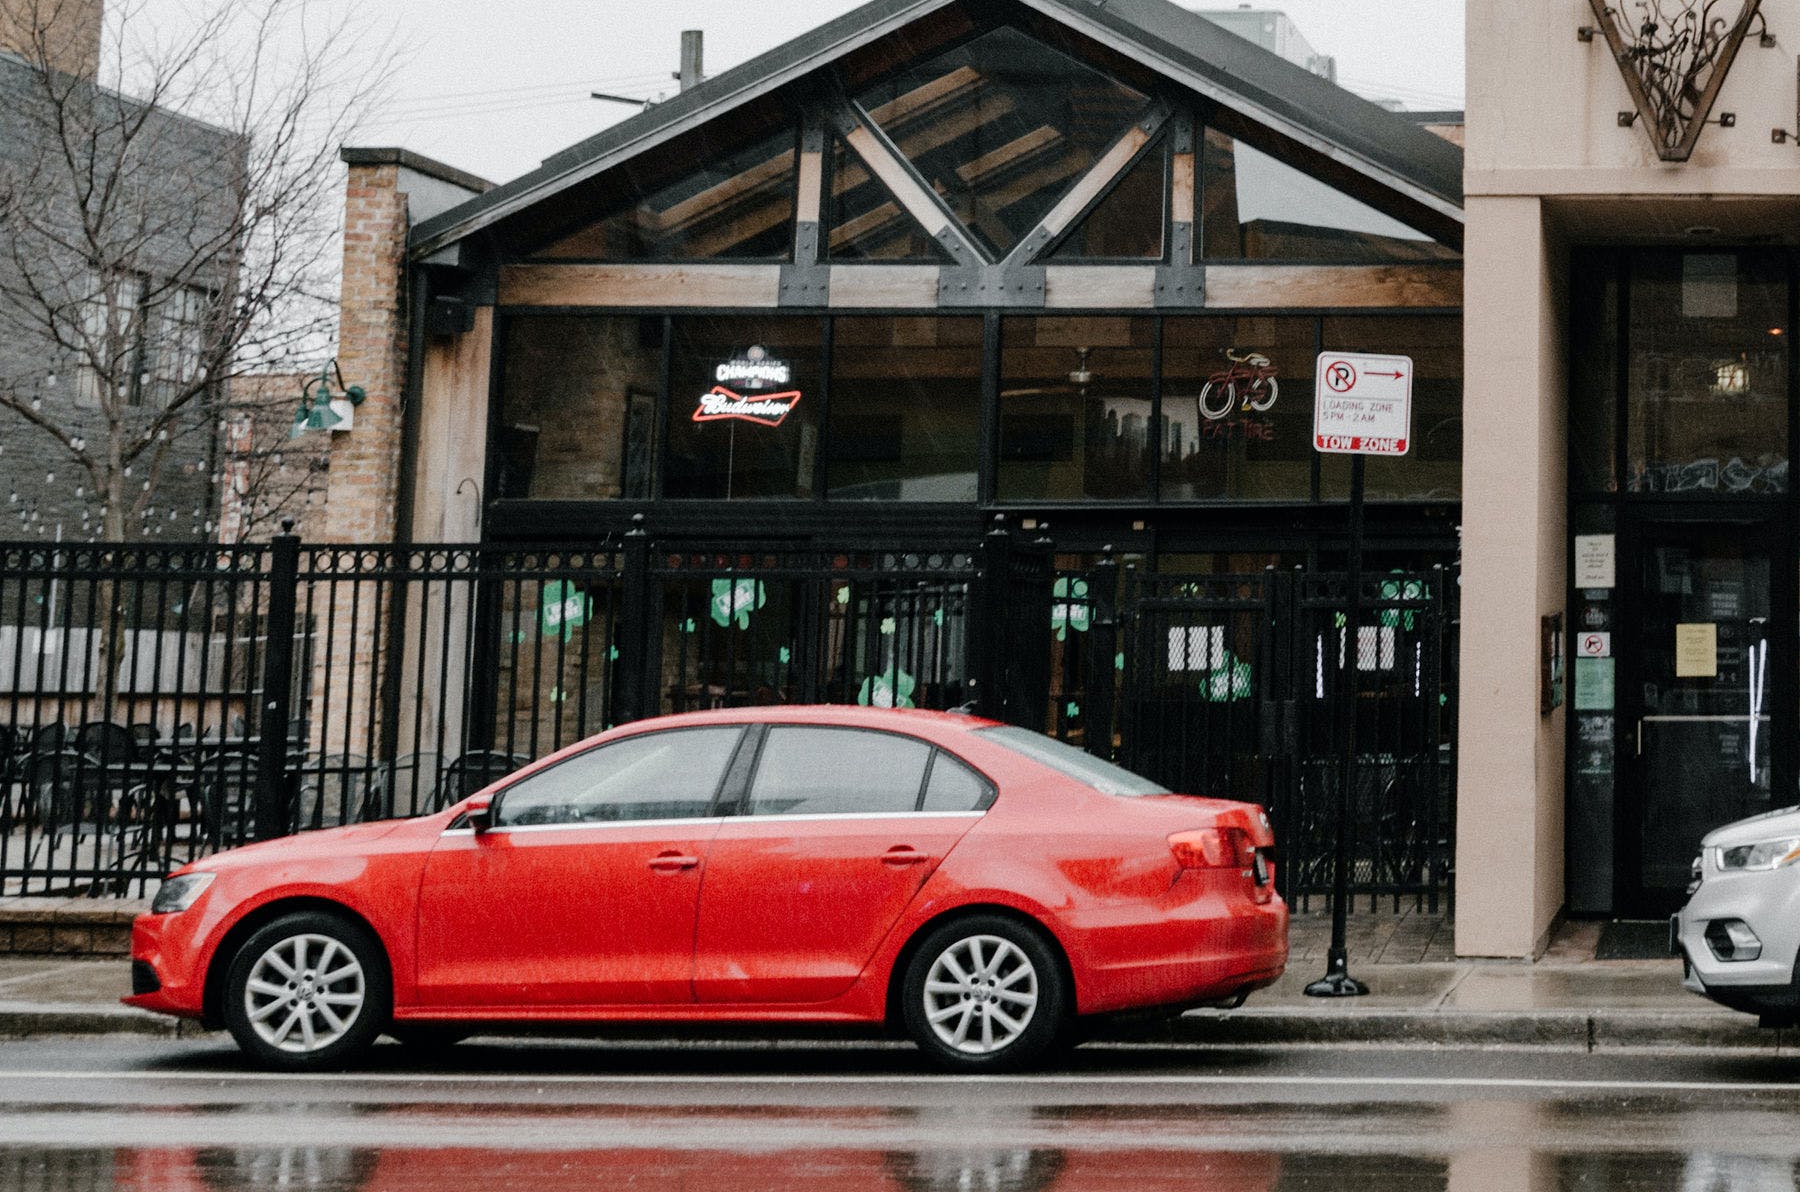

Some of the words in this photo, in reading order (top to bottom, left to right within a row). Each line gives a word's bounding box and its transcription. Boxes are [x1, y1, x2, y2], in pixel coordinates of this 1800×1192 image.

[1323, 400, 1364, 411] LOADING
[1369, 403, 1394, 413] ZONE
[1321, 436, 1352, 450] TOW
[1359, 438, 1399, 452] ZONE
